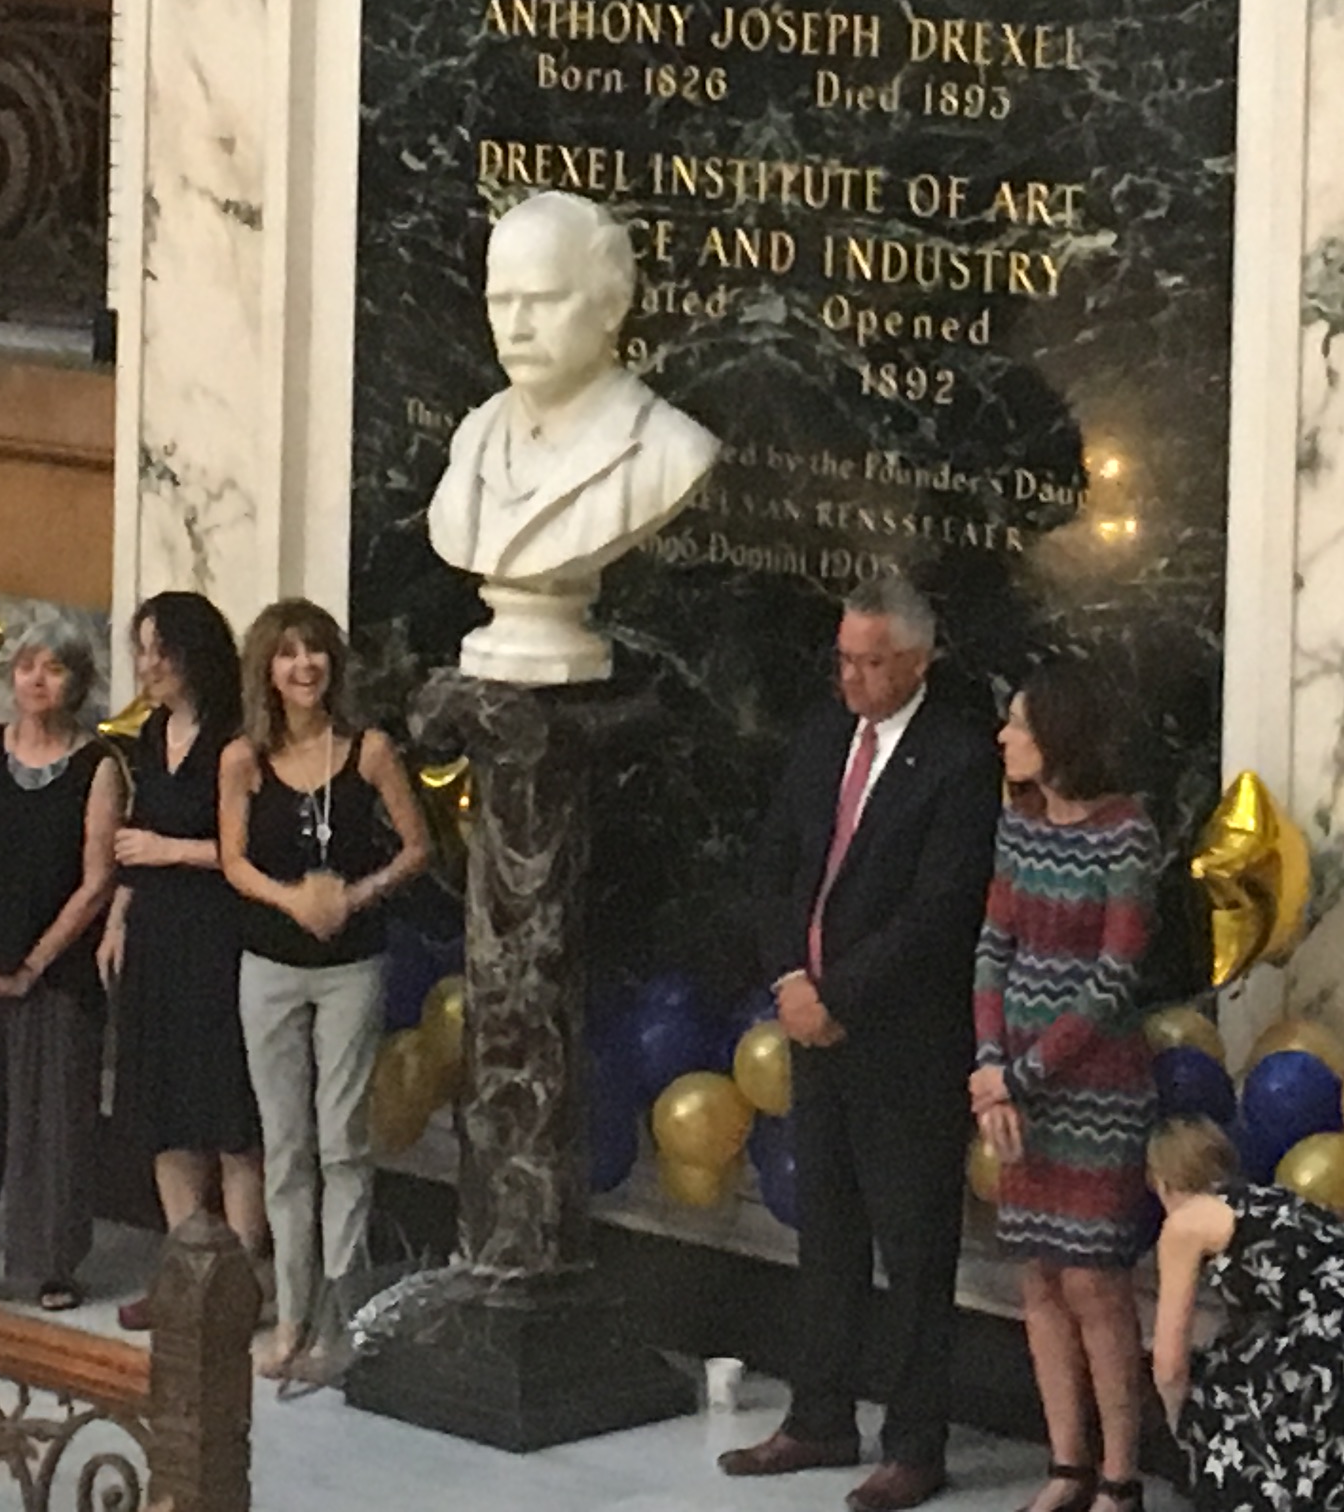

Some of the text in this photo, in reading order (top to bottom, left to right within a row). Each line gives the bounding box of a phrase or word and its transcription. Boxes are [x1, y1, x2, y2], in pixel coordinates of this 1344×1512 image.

[710, 6, 880, 58] JOSEPH
[908, 17, 1084, 71] DREXEL
[537, 52, 1012, 120] Born 1826 Died 1893
[478, 140, 1086, 228] DREXEL INSTITUTE OF ART
[697, 226, 796, 275] AND
[823, 235, 1068, 298] INDUSTRY
[822, 294, 991, 348] Opened
[857, 362, 957, 405] 1892
[809, 450, 856, 480] the
